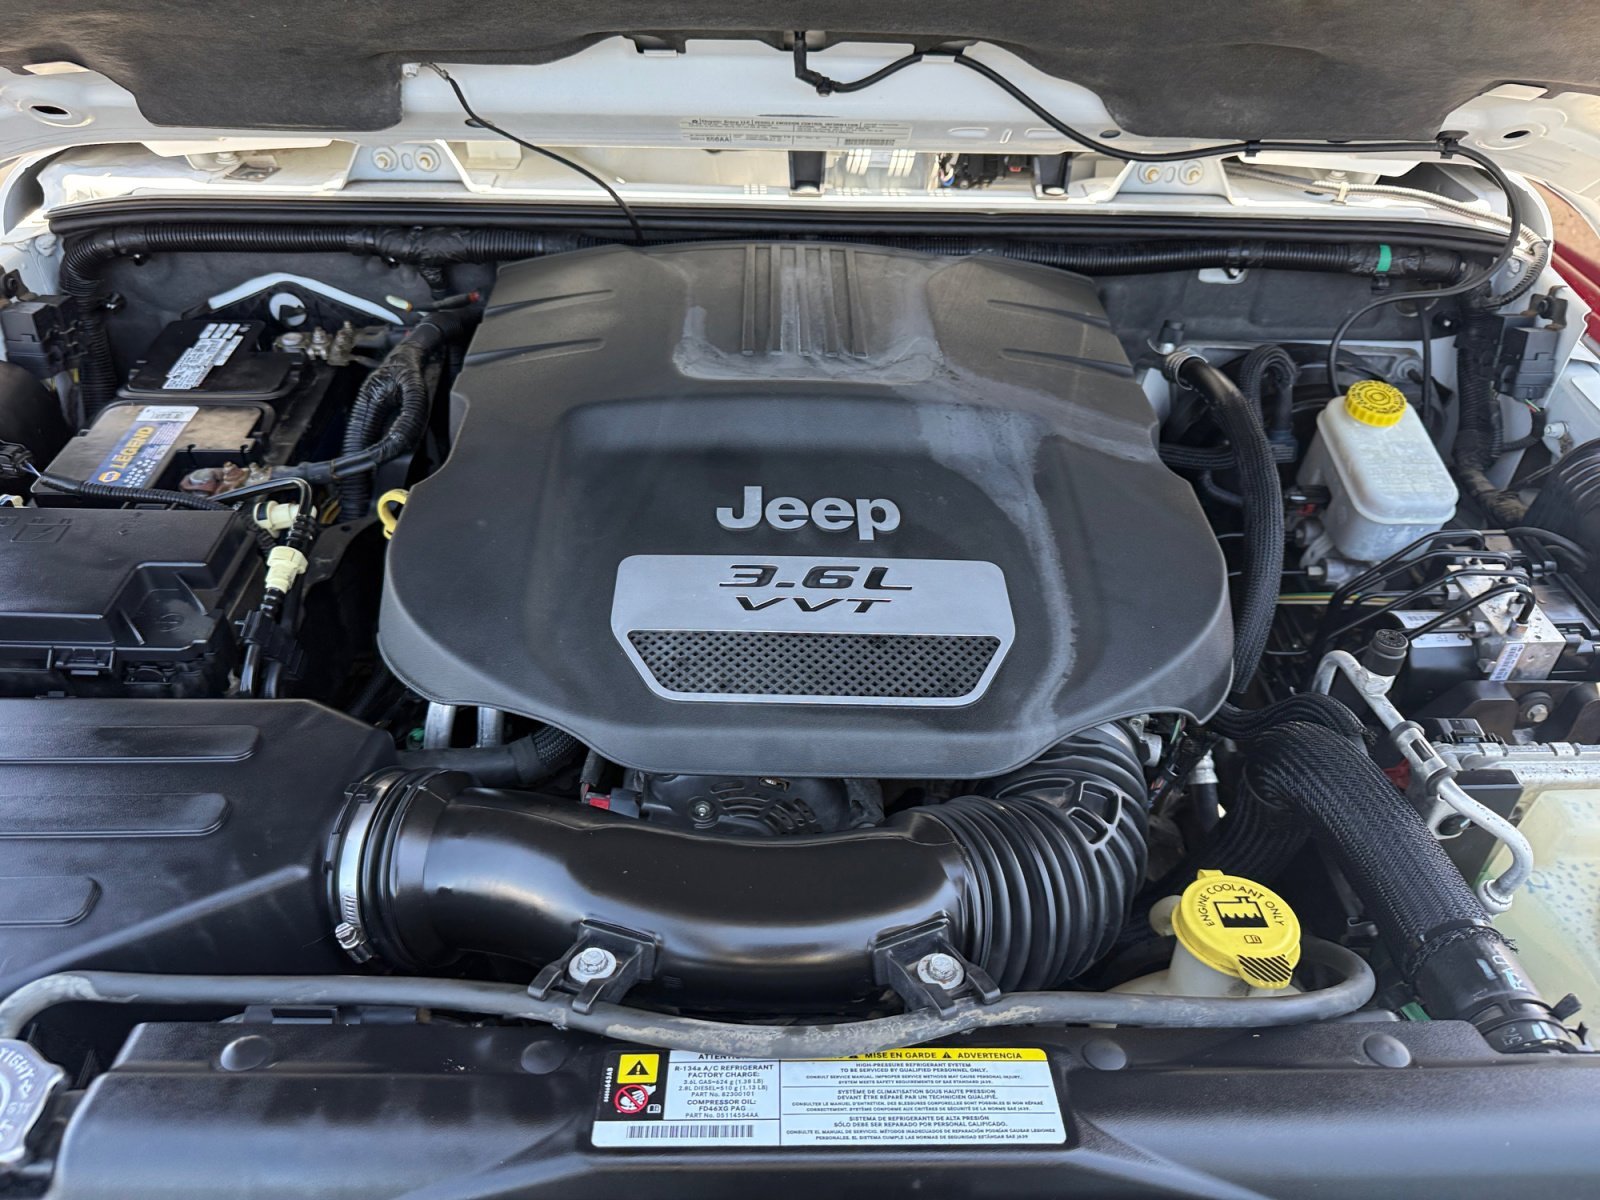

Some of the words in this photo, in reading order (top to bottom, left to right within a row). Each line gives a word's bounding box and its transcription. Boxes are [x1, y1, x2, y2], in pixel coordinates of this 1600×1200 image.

[110, 426, 156, 468] LEGEND
[716, 486, 900, 542] Jeep
[719, 564, 912, 590] 3.6L
[736, 596, 892, 613] VVT
[1197, 894, 1214, 927] ENGINE
[1206, 884, 1264, 900] COOLANT
[1265, 900, 1285, 926] ONLY
